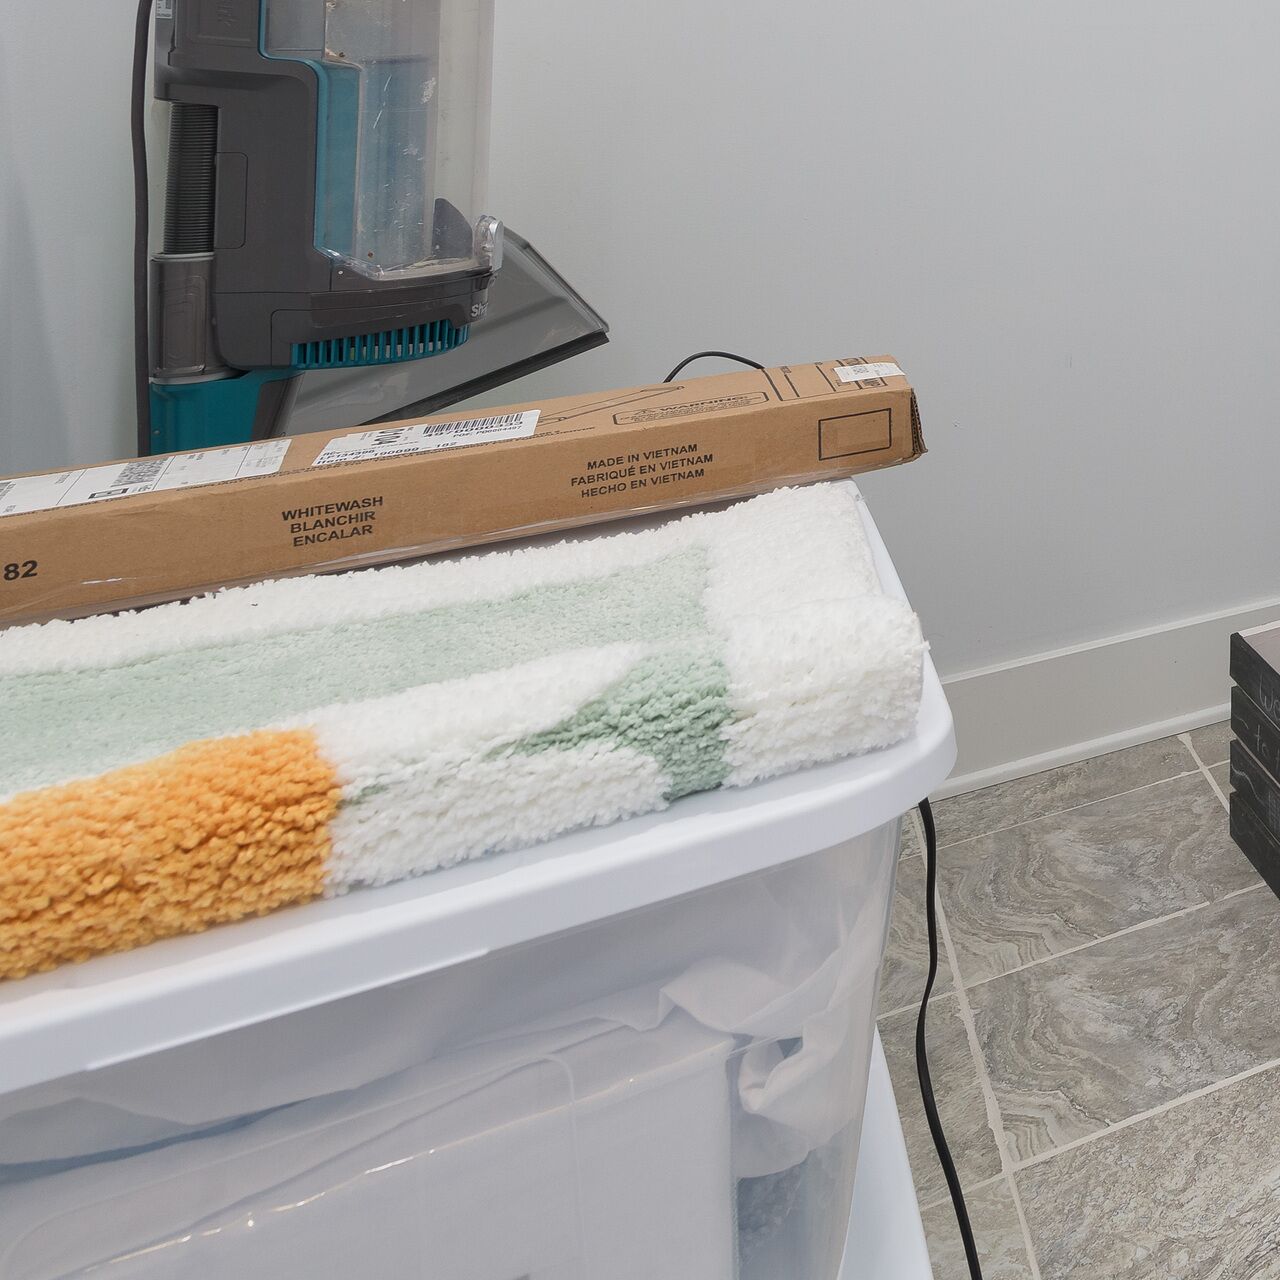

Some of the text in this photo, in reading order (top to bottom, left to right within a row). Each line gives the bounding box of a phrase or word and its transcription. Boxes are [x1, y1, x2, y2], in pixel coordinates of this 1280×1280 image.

[587, 443, 698, 470] MADE IN VIETNAM
[571, 453, 713, 487] FABRIQUÉ EN VIETNAM
[581, 468, 705, 498] HECHO EN VIETNAM
[282, 496, 384, 522] WHITEWASH
[290, 510, 376, 534] BLANCHIR
[293, 524, 373, 547] ENCALAR
[3, 559, 39, 581] 82
